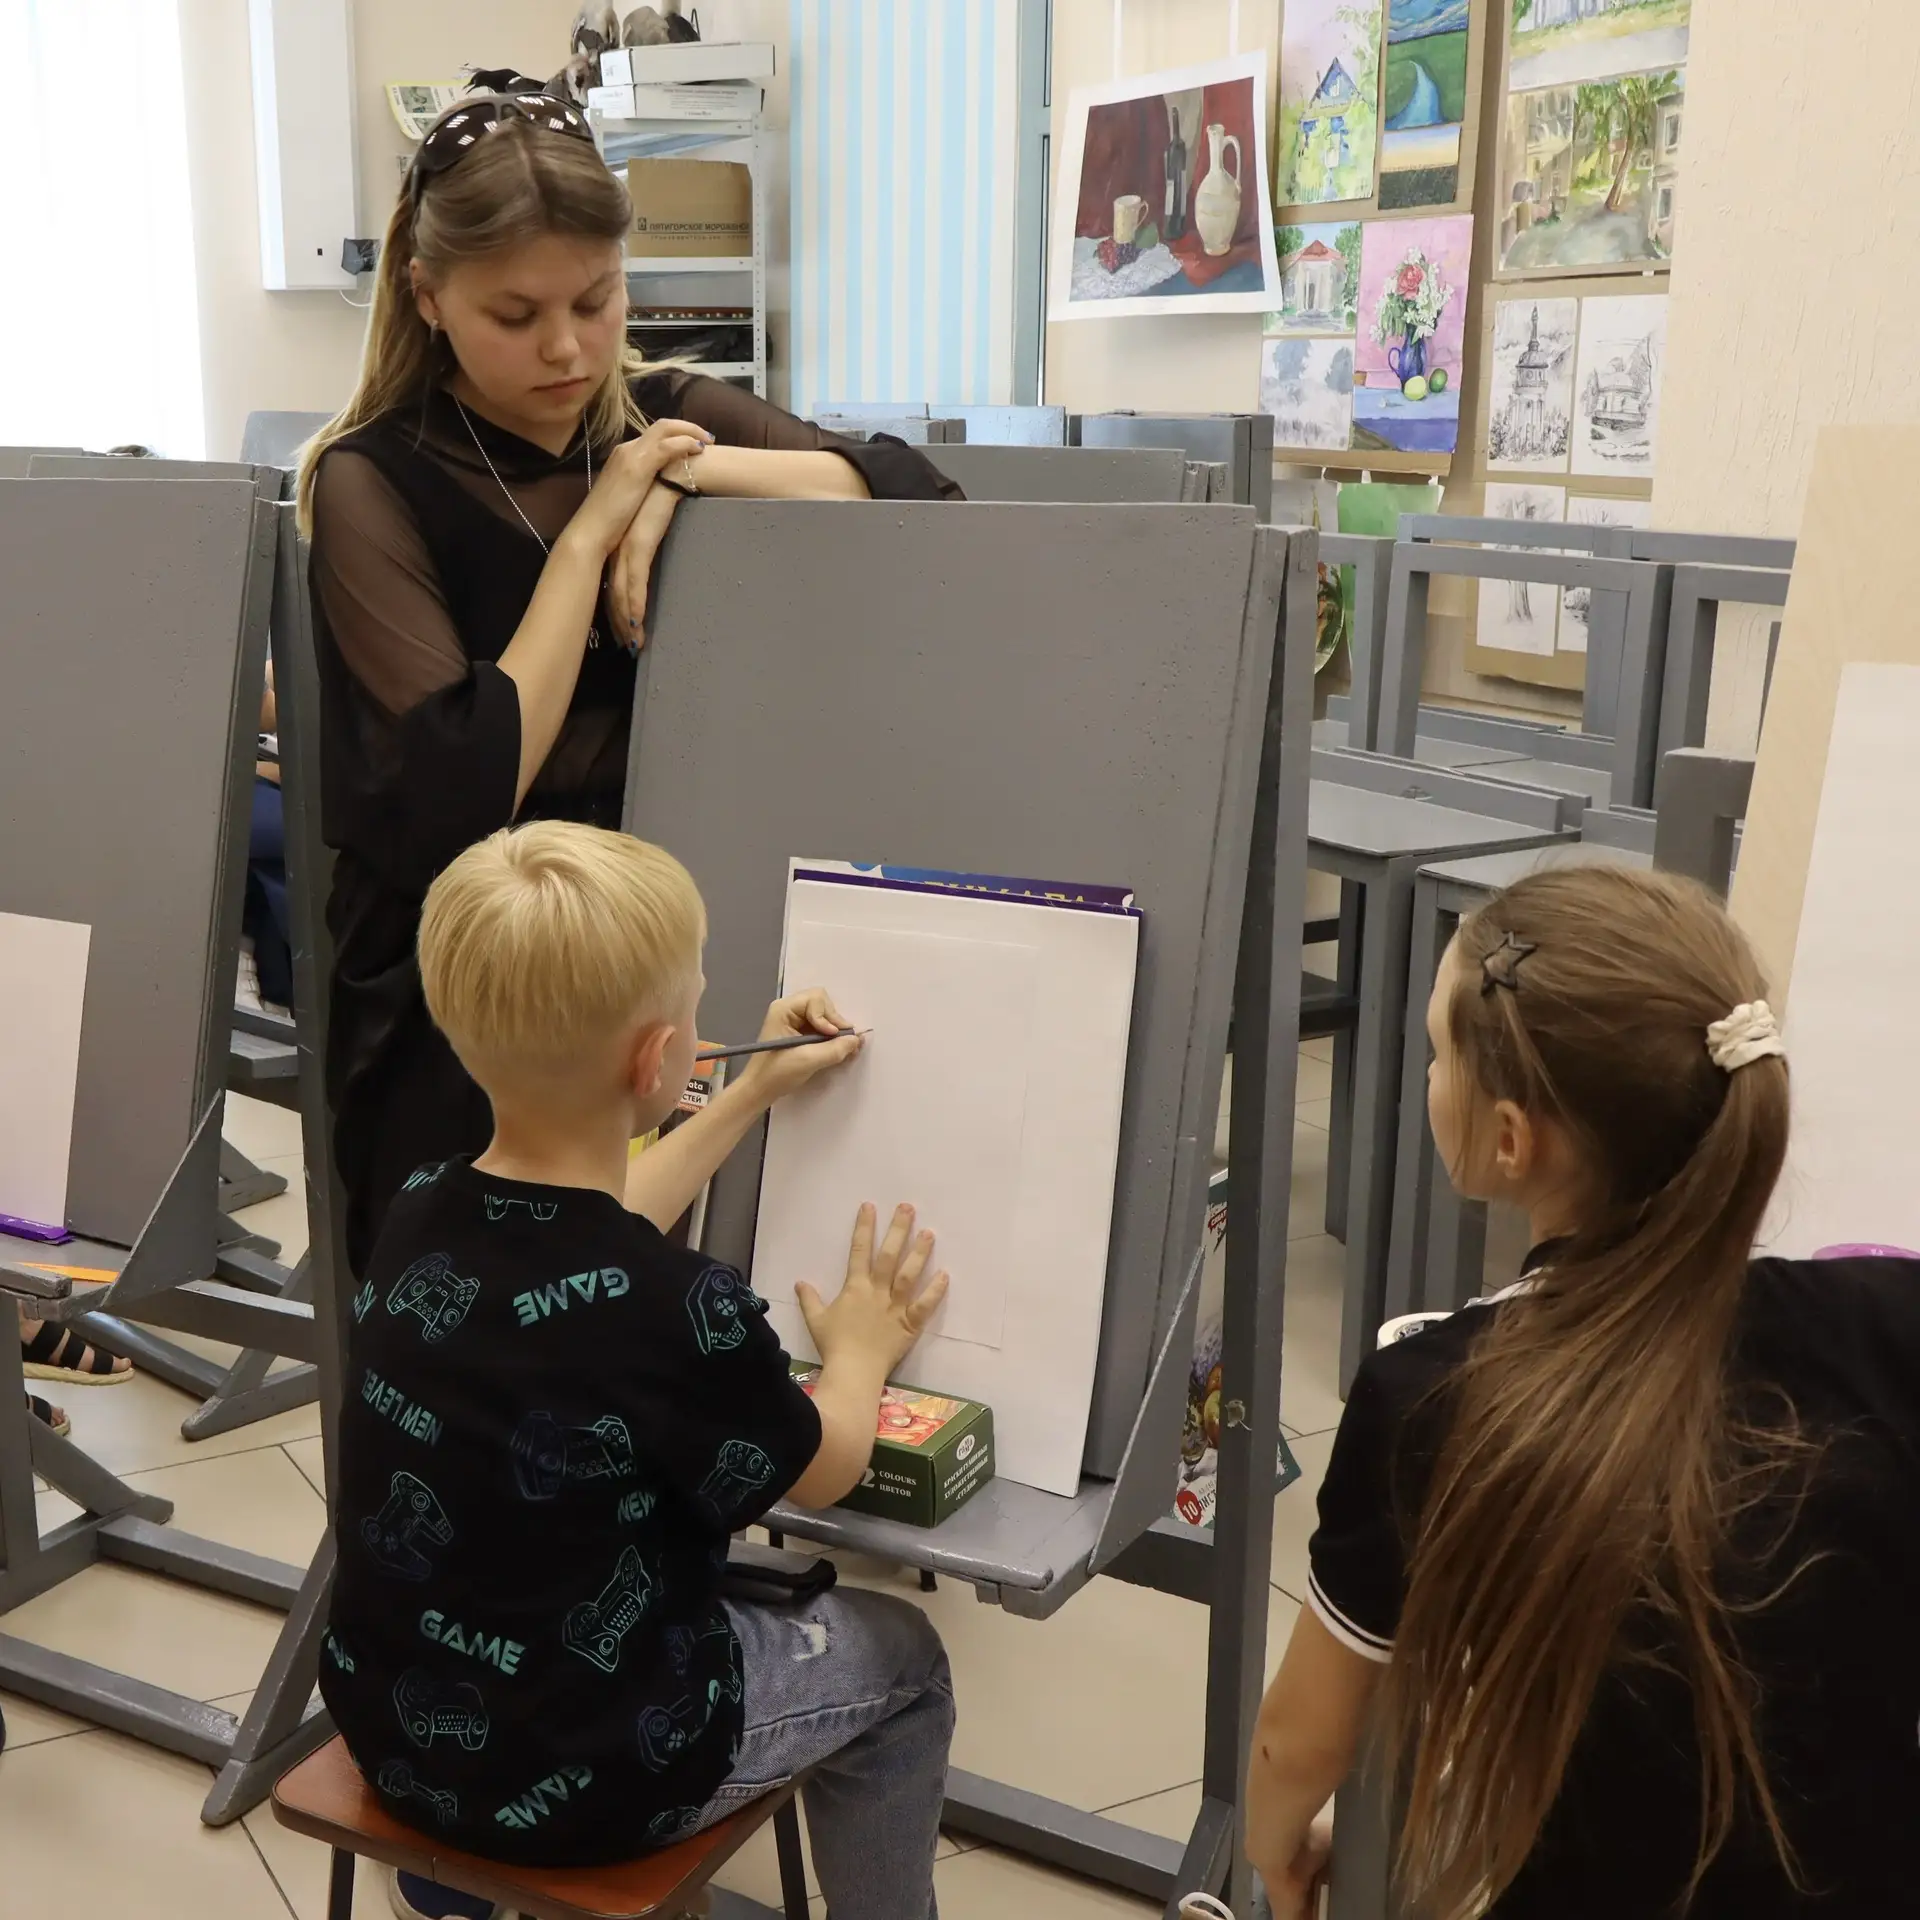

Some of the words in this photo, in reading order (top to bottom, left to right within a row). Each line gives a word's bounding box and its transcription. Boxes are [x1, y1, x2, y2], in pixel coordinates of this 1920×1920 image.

[649, 222, 703, 231] ПЯТИГОРСКОЕ
[688, 1081, 703, 1091] ata
[682, 1093, 702, 1104] СТЕЙ
[512, 1266, 630, 1327] GAME
[361, 1367, 405, 1422] LEVEL
[399, 1401, 443, 1446] NEW
[878, 1470, 917, 1486] COLOURS
[879, 1483, 912, 1498] ЦВЕТОВ
[1182, 1500, 1199, 1520] 10
[420, 1609, 526, 1676] GAME
[494, 1765, 593, 1829] GAME
